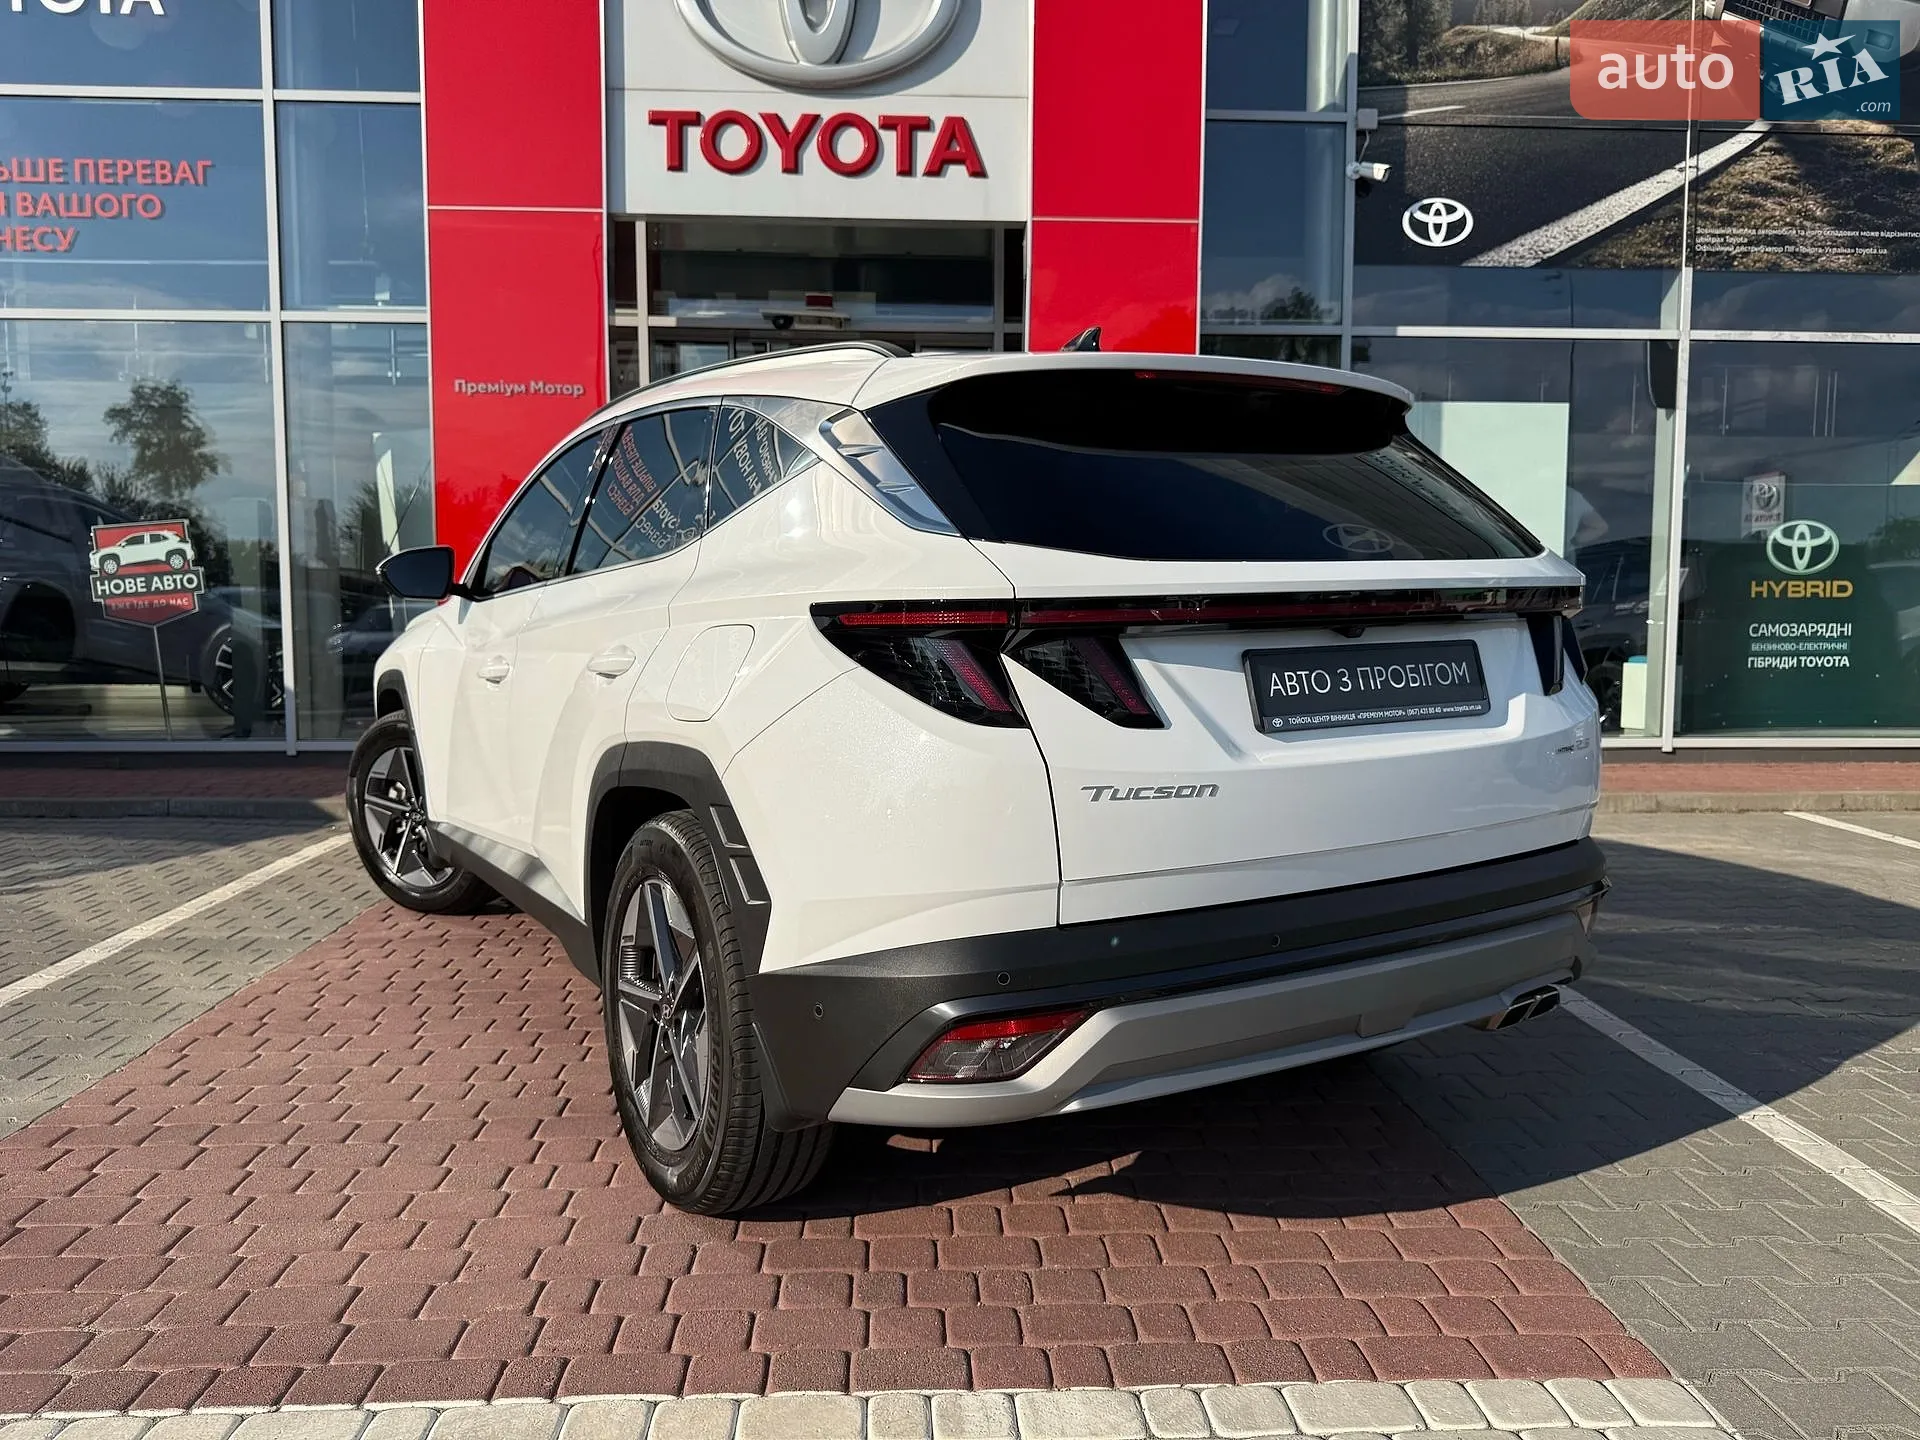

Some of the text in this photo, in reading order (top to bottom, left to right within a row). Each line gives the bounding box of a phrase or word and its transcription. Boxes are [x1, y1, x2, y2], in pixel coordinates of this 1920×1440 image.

[648, 110, 989, 178] TOYOTA
[74, 158, 213, 185] ПЕРЕВАГ
[16, 191, 163, 219] ВАШОГО
[454, 378, 585, 397] Преміум Мотор
[96, 573, 198, 595] НОВЕ АВТО
[1751, 580, 1854, 598] HYBRID
[1749, 623, 1852, 638] САМОЗАРЯДНІ
[1751, 641, 1848, 652] БЕНЗИНОВО-ЕЛЕКТРИЧНІ
[1748, 655, 1850, 670] ГІБРИДИ TOYOTA
[1270, 669, 1331, 698] АВТО
[1357, 661, 1471, 691] ПРОБІГОМ
[1312, 714, 1330, 724] ЦЕНТР
